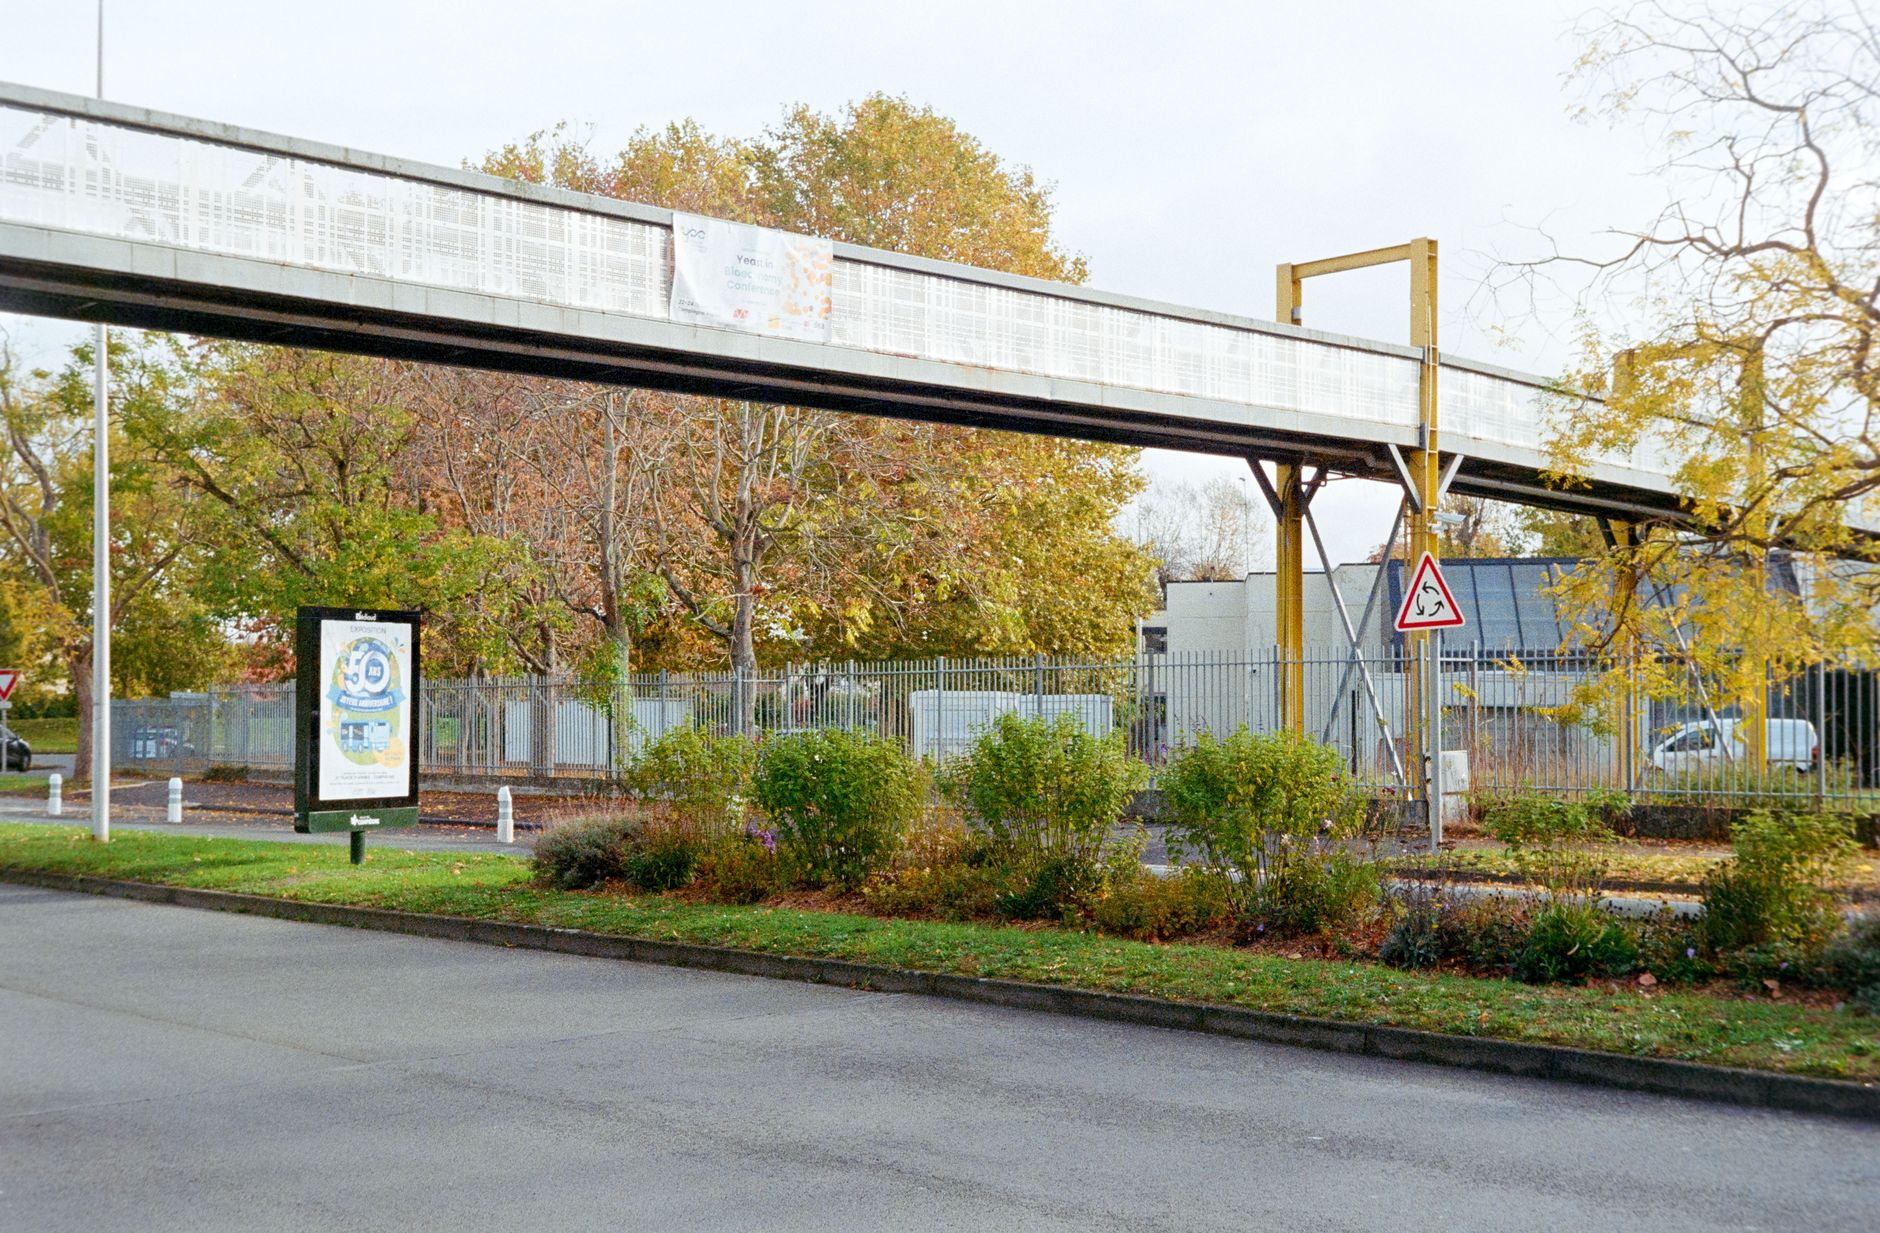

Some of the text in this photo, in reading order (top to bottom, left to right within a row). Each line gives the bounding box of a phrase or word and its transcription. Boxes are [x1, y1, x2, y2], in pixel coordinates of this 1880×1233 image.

[736, 254, 774, 269] Yeast in
[724, 265, 784, 287] Bioecnomy
[727, 279, 781, 297] Conference
[350, 624, 387, 634] EXPOSITION
[343, 650, 392, 694] 50
[367, 666, 382, 677] ANS
